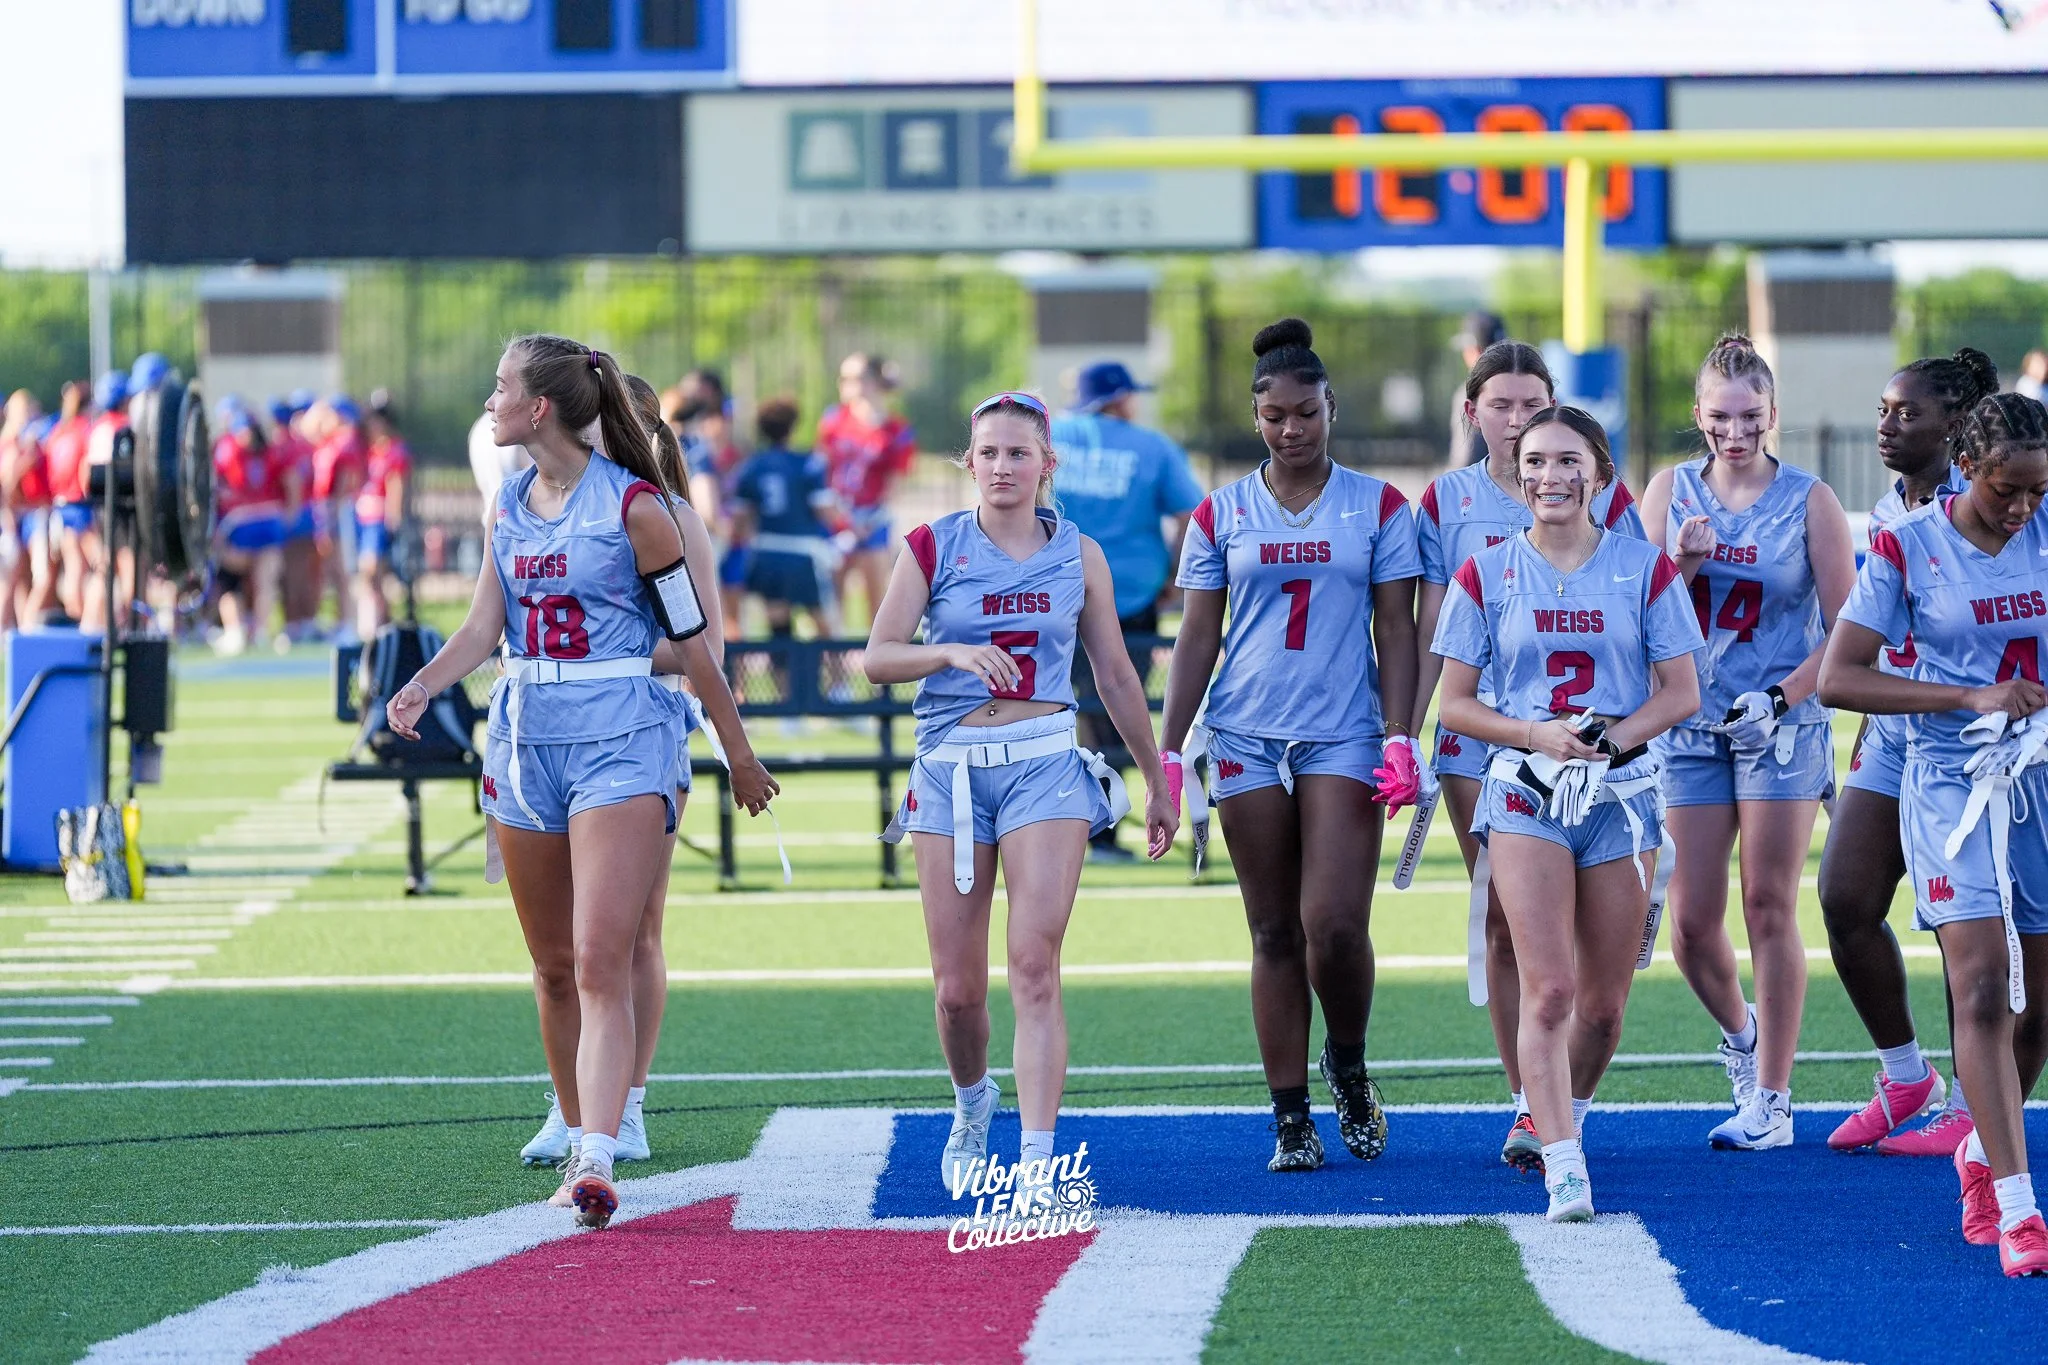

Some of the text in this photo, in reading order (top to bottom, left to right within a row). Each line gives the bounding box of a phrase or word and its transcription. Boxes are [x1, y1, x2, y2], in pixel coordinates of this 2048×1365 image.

[514, 553, 567, 580] WEISS
[1260, 540, 1331, 564] WEISS
[982, 592, 1051, 616] WEISS
[1281, 579, 1312, 651] 1
[1533, 609, 1605, 634] WEISS
[1969, 590, 2048, 625] WEISS
[518, 594, 591, 660] 18
[988, 631, 1039, 700] 5
[1546, 650, 1596, 714] 2
